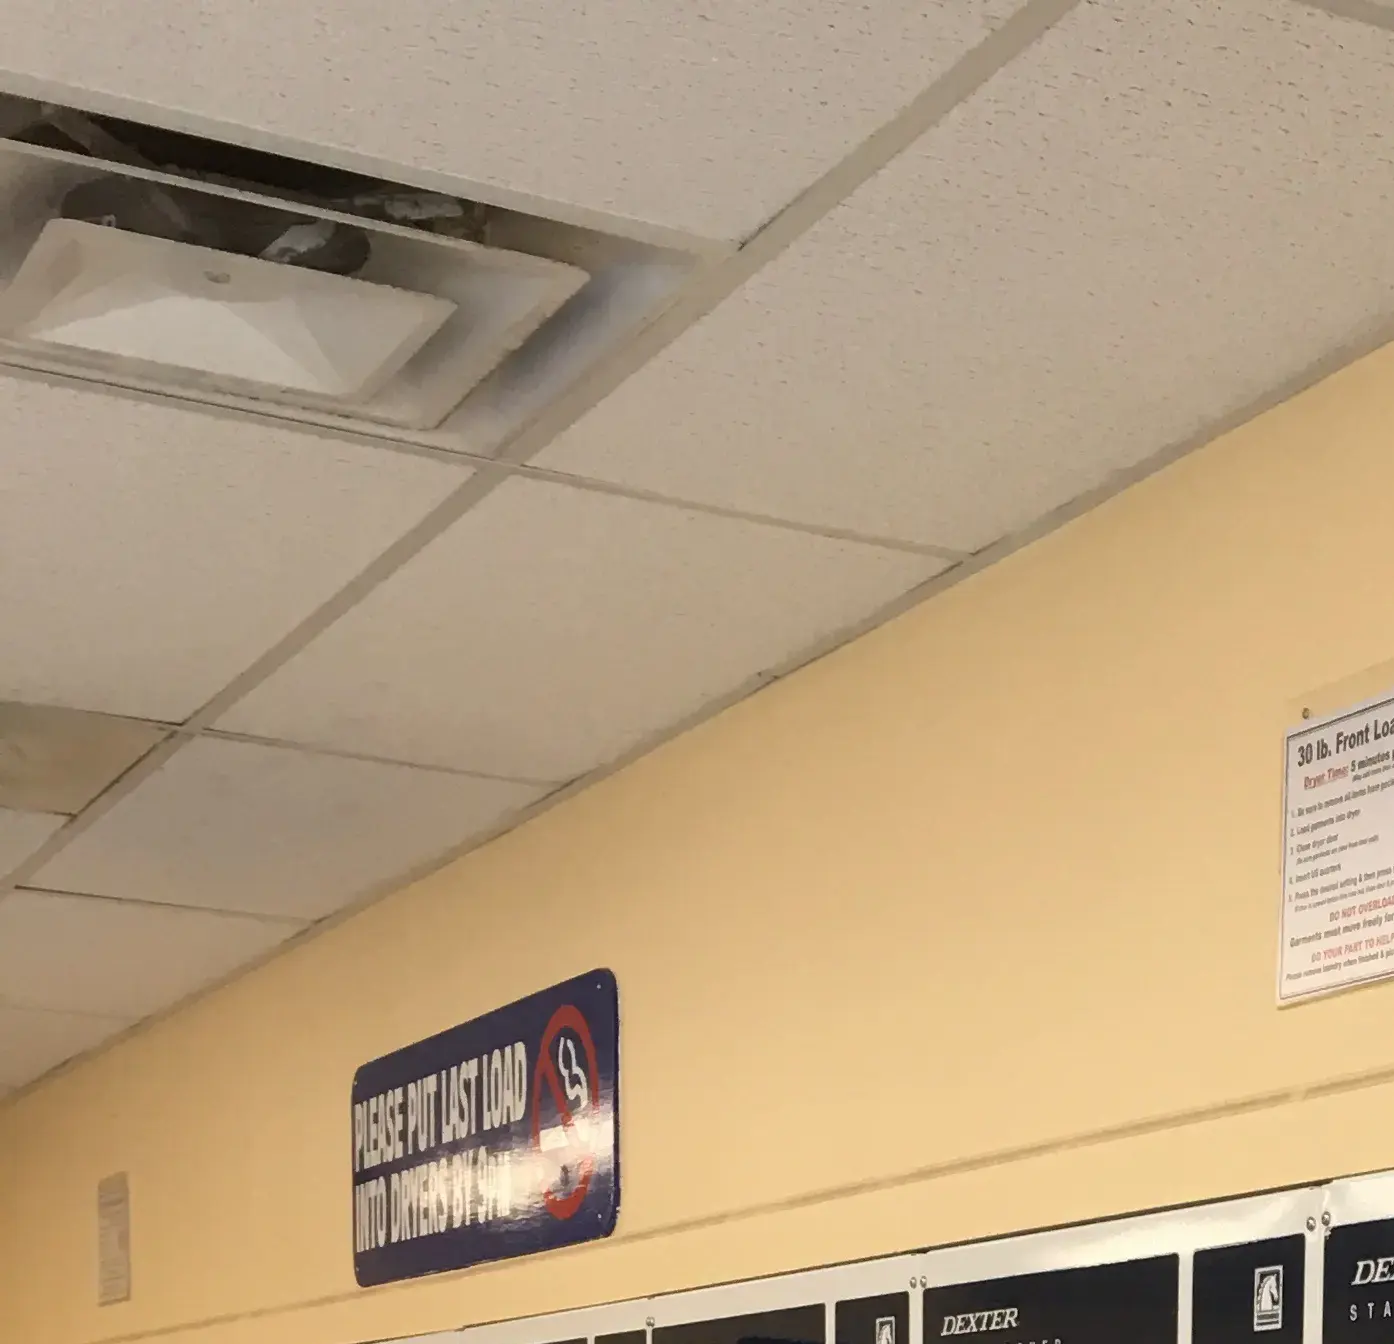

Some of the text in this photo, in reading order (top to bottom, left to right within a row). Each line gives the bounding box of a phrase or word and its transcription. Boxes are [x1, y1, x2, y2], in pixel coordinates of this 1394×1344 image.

[1297, 742, 1312, 767] 30
[1316, 738, 1331, 760] lb.
[1335, 722, 1369, 754] Front
[1303, 773, 1325, 790] Dryer
[1350, 759, 1356, 772] 5
[1357, 750, 1390, 770] minutes
[354, 1041, 527, 1172] PLEASE PUT LAST LOAD
[356, 1176, 388, 1253] INTO
[390, 1156, 448, 1243] DRYERS
[940, 1307, 1021, 1338] DEXTER
